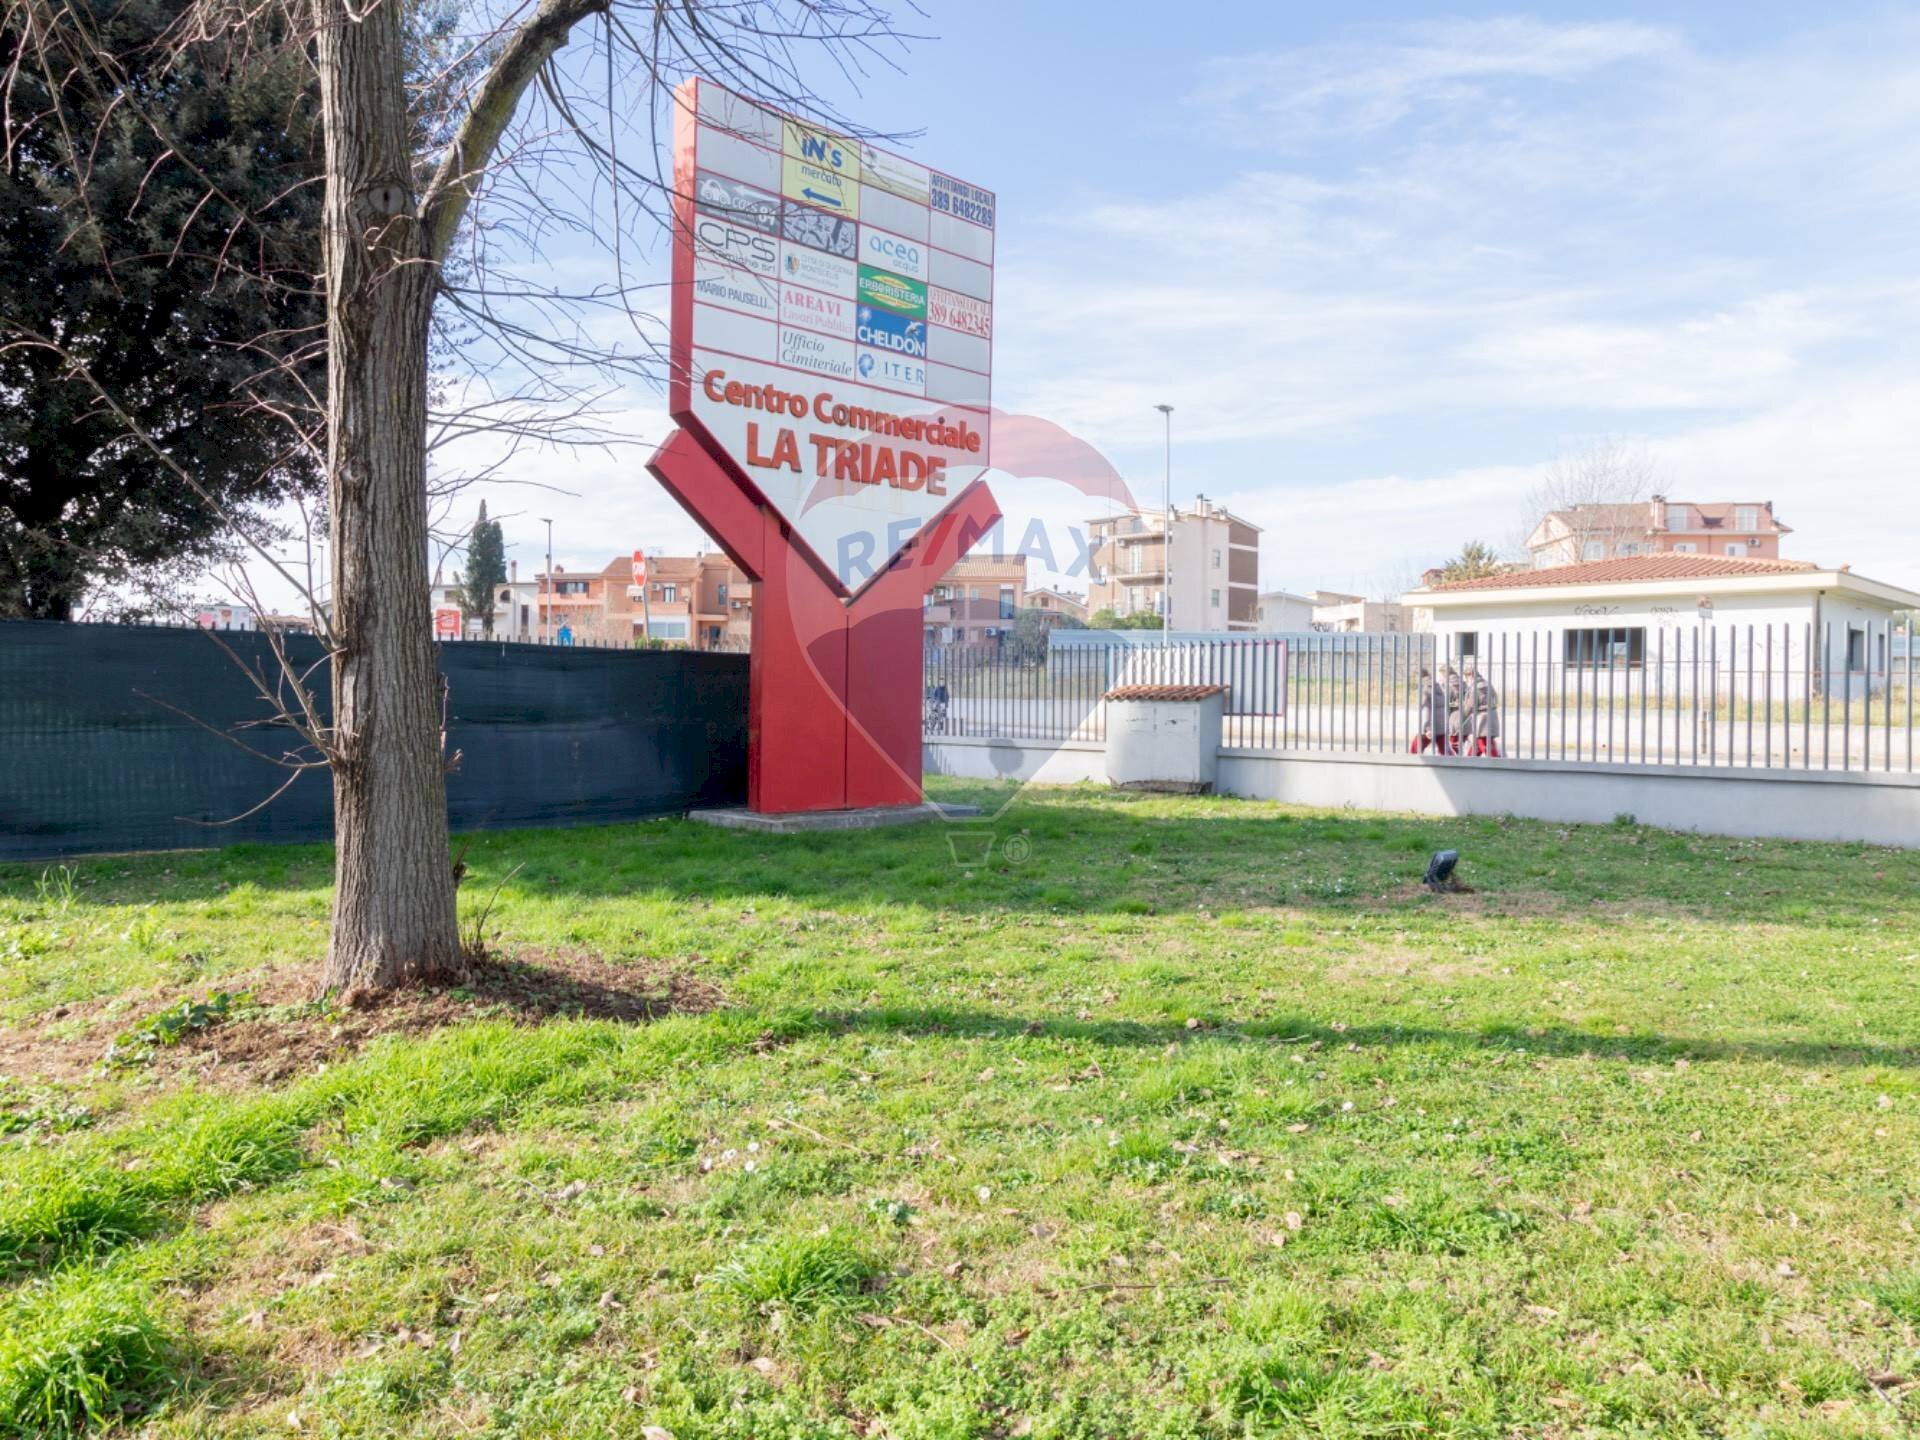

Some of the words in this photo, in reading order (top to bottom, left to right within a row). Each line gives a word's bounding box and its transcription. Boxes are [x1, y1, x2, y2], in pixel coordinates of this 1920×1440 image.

[801, 165, 842, 188] mercato
[931, 188, 950, 211] 389
[699, 222, 776, 263] CPS
[870, 235, 919, 265] acea
[696, 279, 727, 298] MARIO
[727, 288, 767, 308] PAUSELLI
[784, 290, 825, 313] AREA
[859, 276, 926, 305] ERBORISTERIA
[928, 301, 947, 323] 389
[783, 331, 825, 352] Ufficio
[857, 325, 926, 357] CHELIDON
[782, 348, 852, 376] Cimiteriale
[884, 361, 924, 383] ITER
[703, 370, 809, 418] Centro
[813, 393, 981, 452] Commerciale
[747, 422, 802, 473] LA
[809, 433, 947, 496] TRIADE
